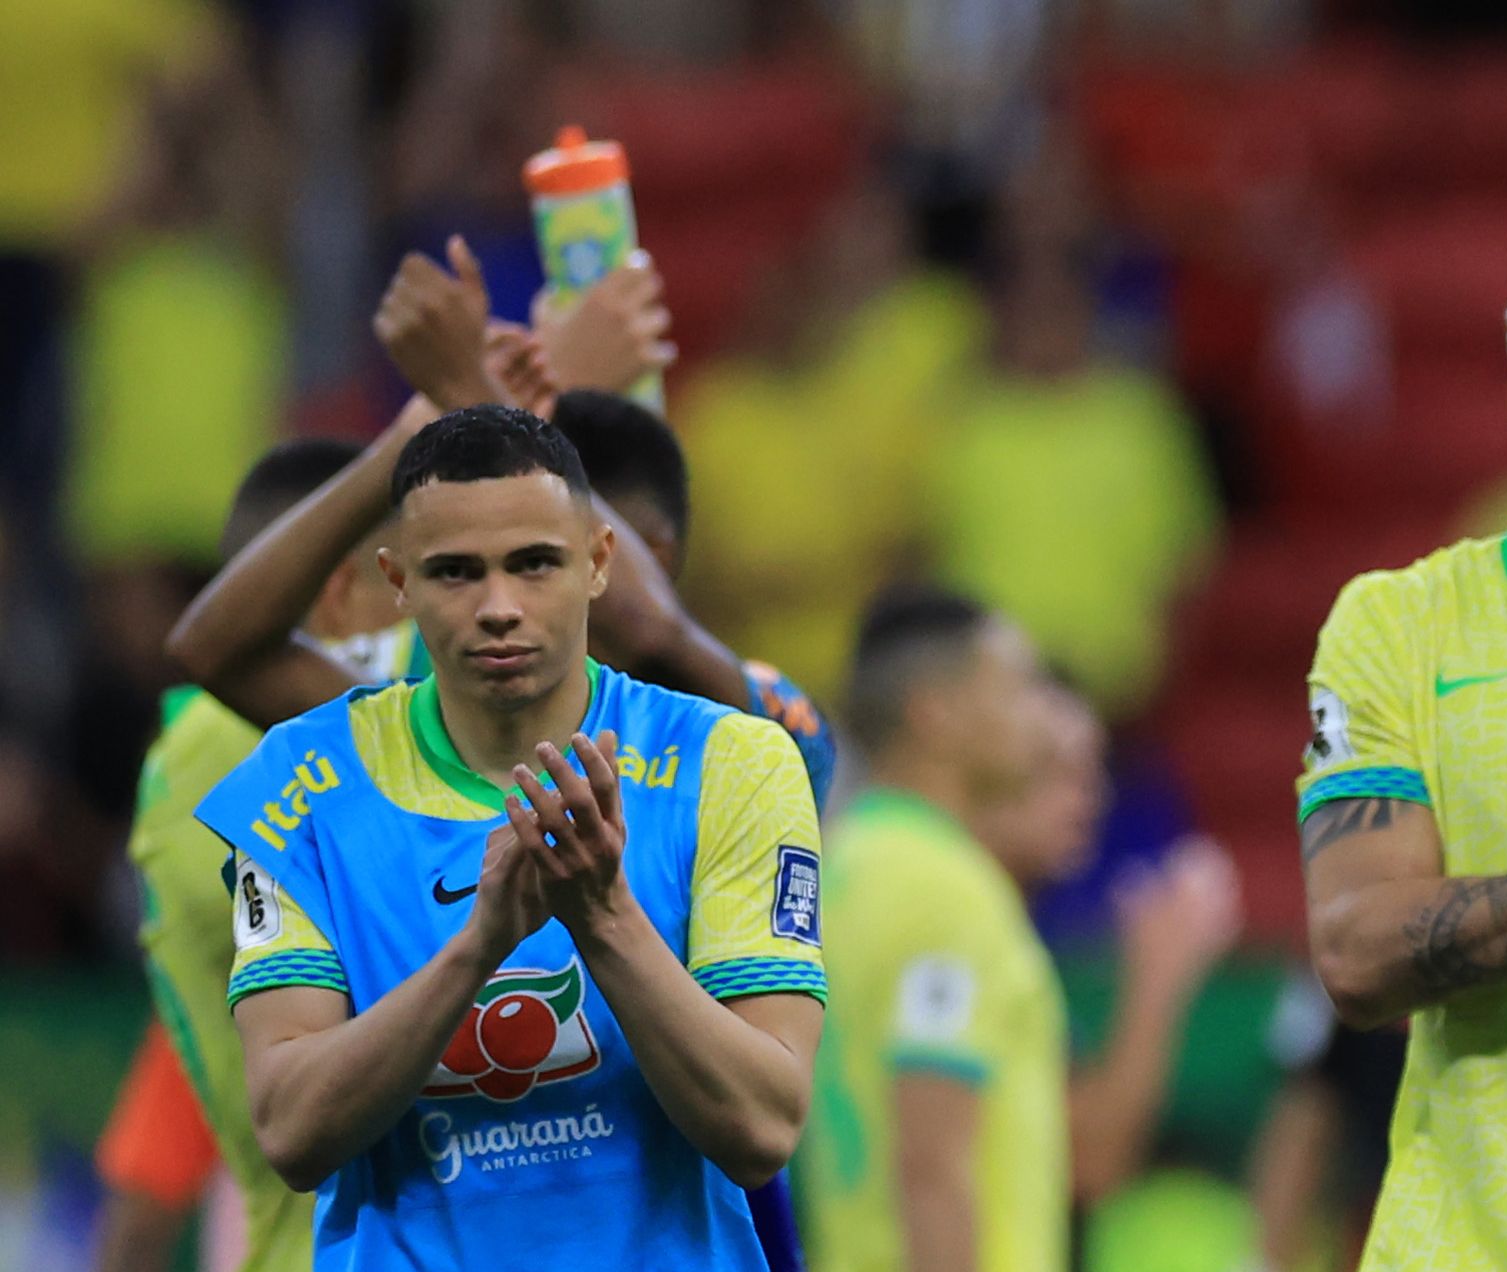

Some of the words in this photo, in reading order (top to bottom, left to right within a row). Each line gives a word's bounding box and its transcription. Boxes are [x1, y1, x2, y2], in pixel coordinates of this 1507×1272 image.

[617, 744, 680, 788] aú
[252, 750, 341, 851] Itaú
[419, 1103, 614, 1184] Guaraná
[481, 1145, 593, 1172] ANTARCTICA
